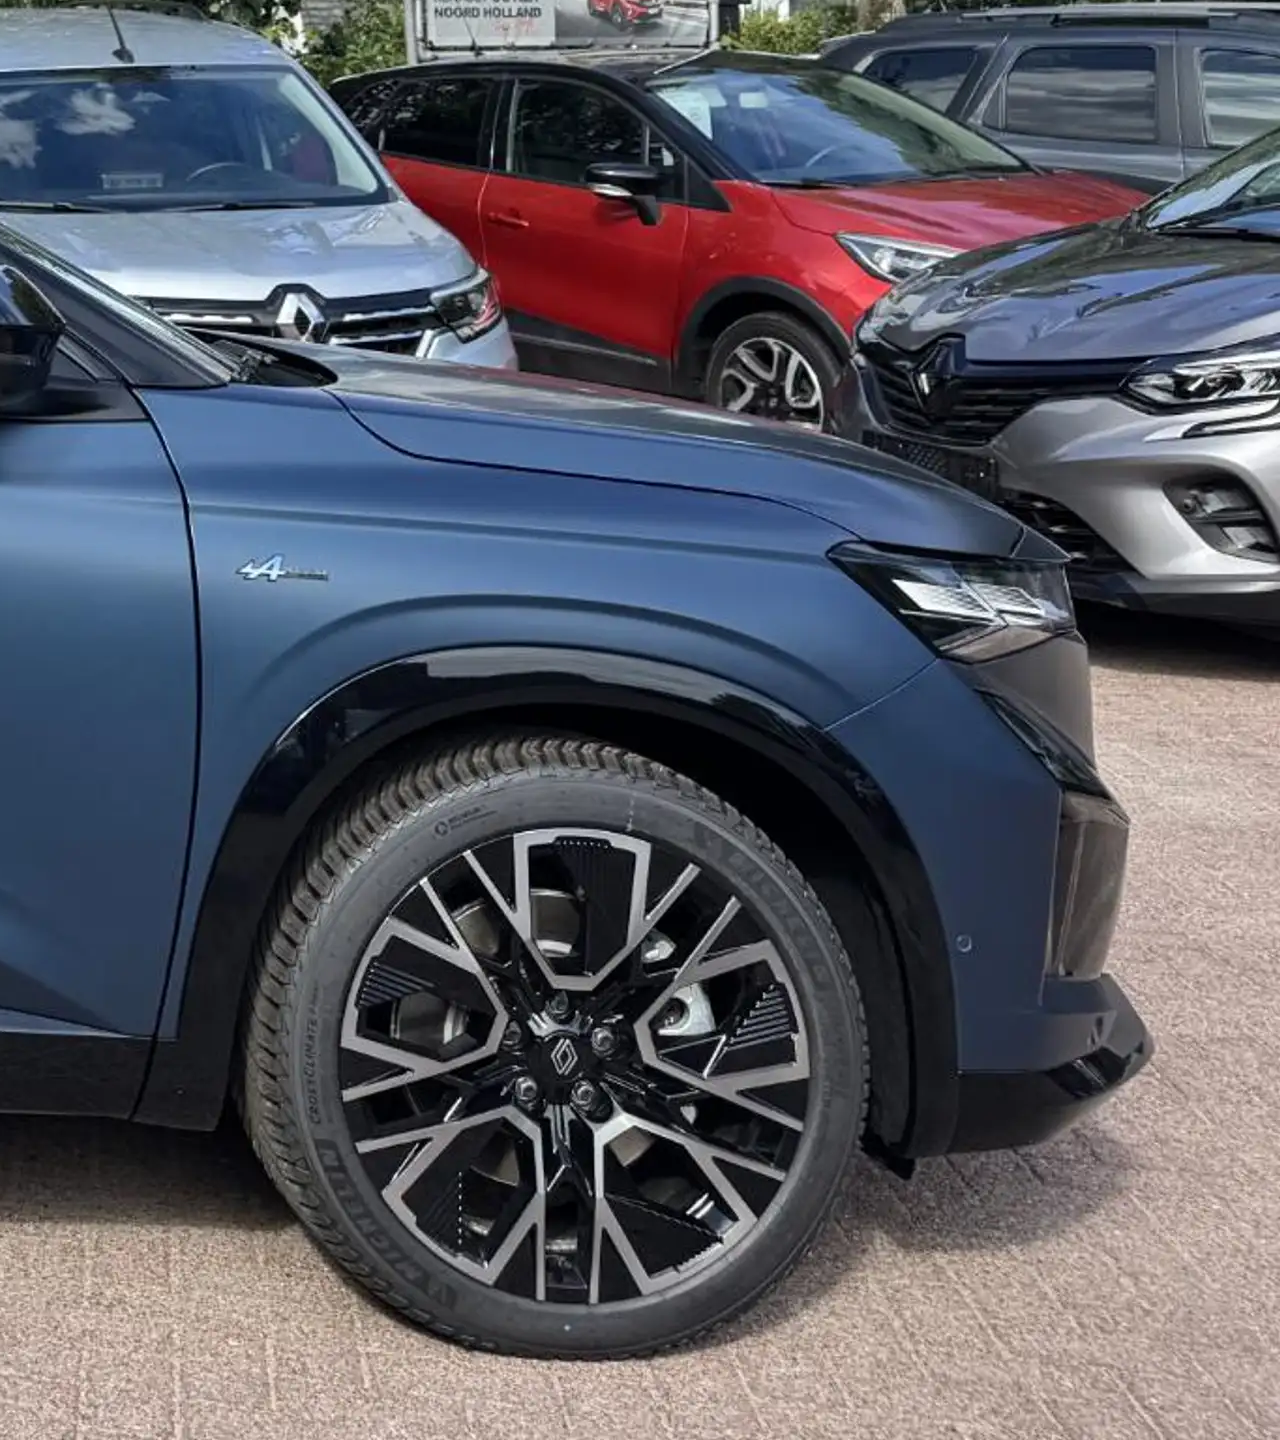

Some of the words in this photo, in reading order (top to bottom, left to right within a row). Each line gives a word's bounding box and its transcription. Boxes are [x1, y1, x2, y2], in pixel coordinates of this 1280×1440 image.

[434, 7, 480, 18] NOORD
[483, 7, 542, 18] HOLLAND
[317, 1142, 427, 1285] MICHELIN
